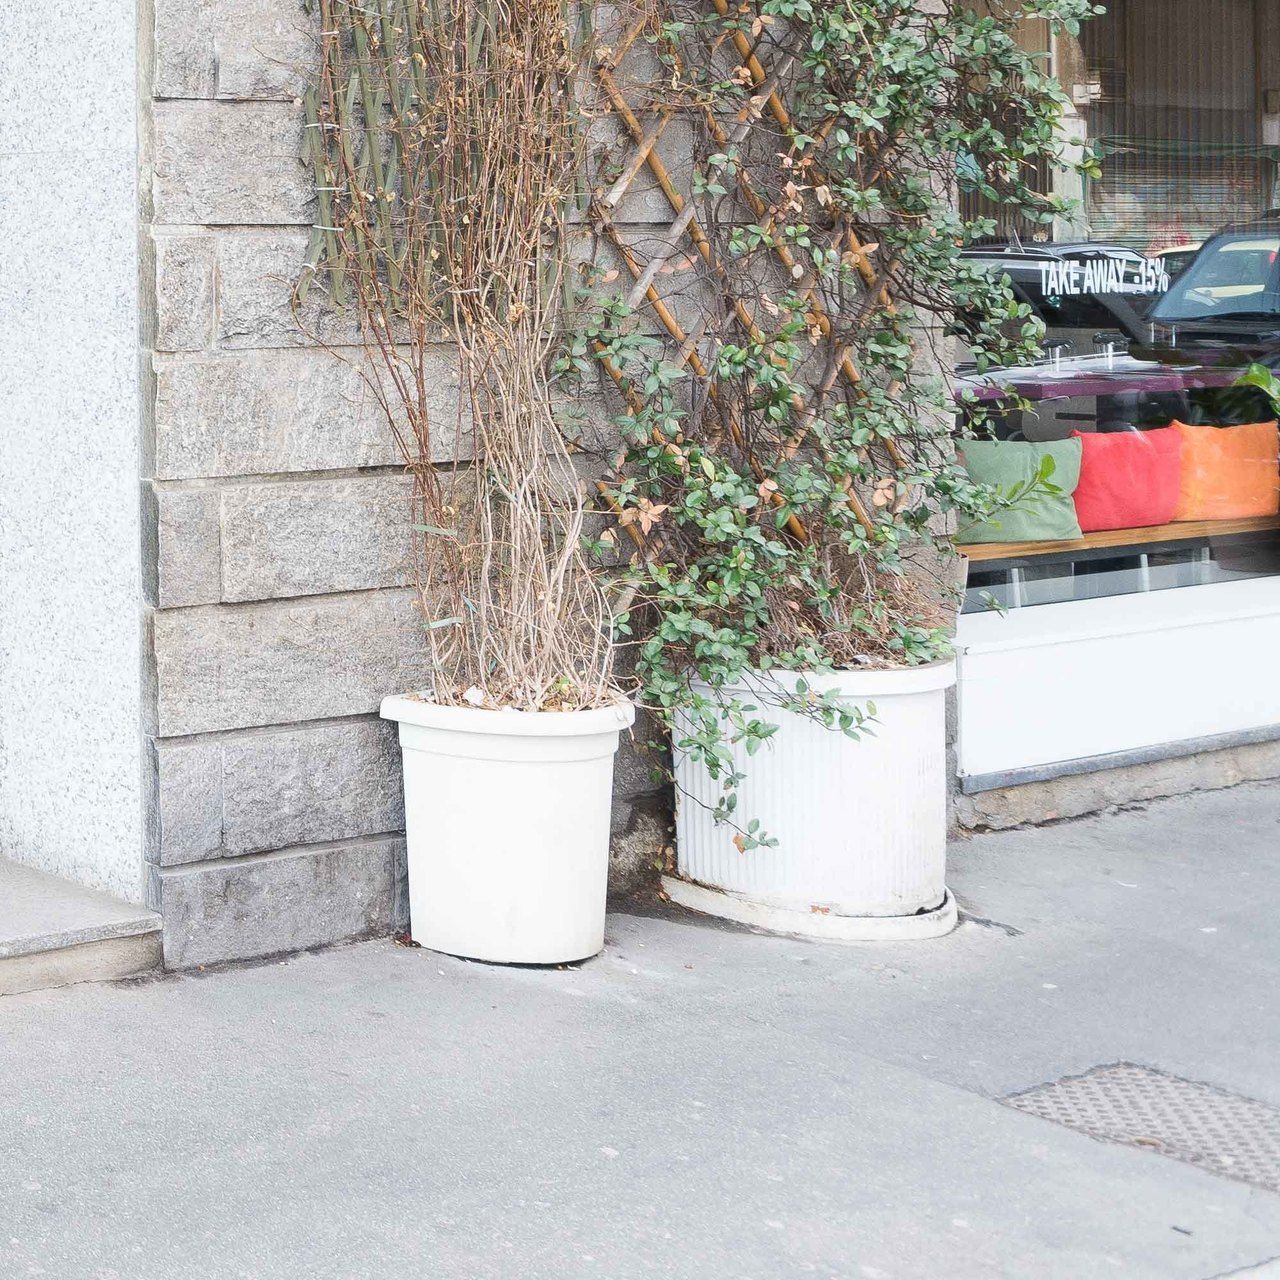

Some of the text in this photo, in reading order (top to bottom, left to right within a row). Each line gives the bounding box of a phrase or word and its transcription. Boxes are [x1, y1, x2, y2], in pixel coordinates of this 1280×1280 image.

[1038, 257, 1169, 296] TAKE AWAY -15%
